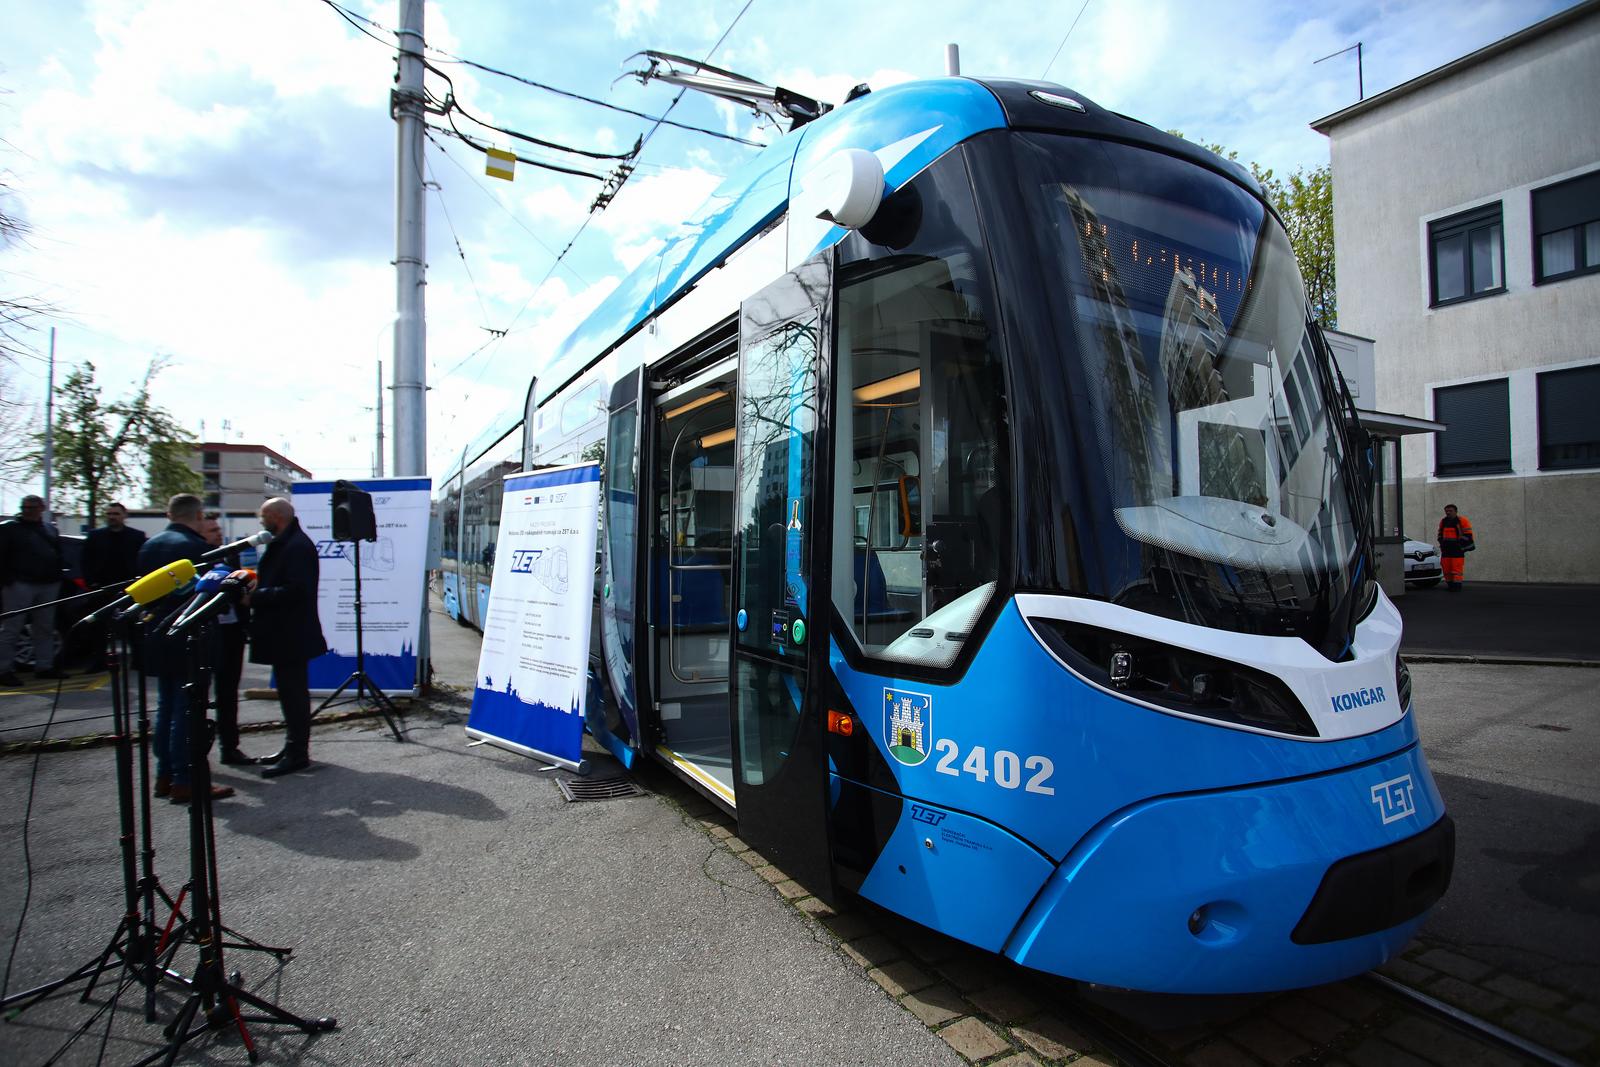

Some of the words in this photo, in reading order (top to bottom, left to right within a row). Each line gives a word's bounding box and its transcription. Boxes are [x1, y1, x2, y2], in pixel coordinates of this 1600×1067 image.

[510, 550, 543, 573] ZET
[1331, 686, 1386, 713] KONČAR
[935, 738, 1055, 796] 2402
[1371, 774, 1416, 825] ZET
[911, 804, 948, 827] ZET
